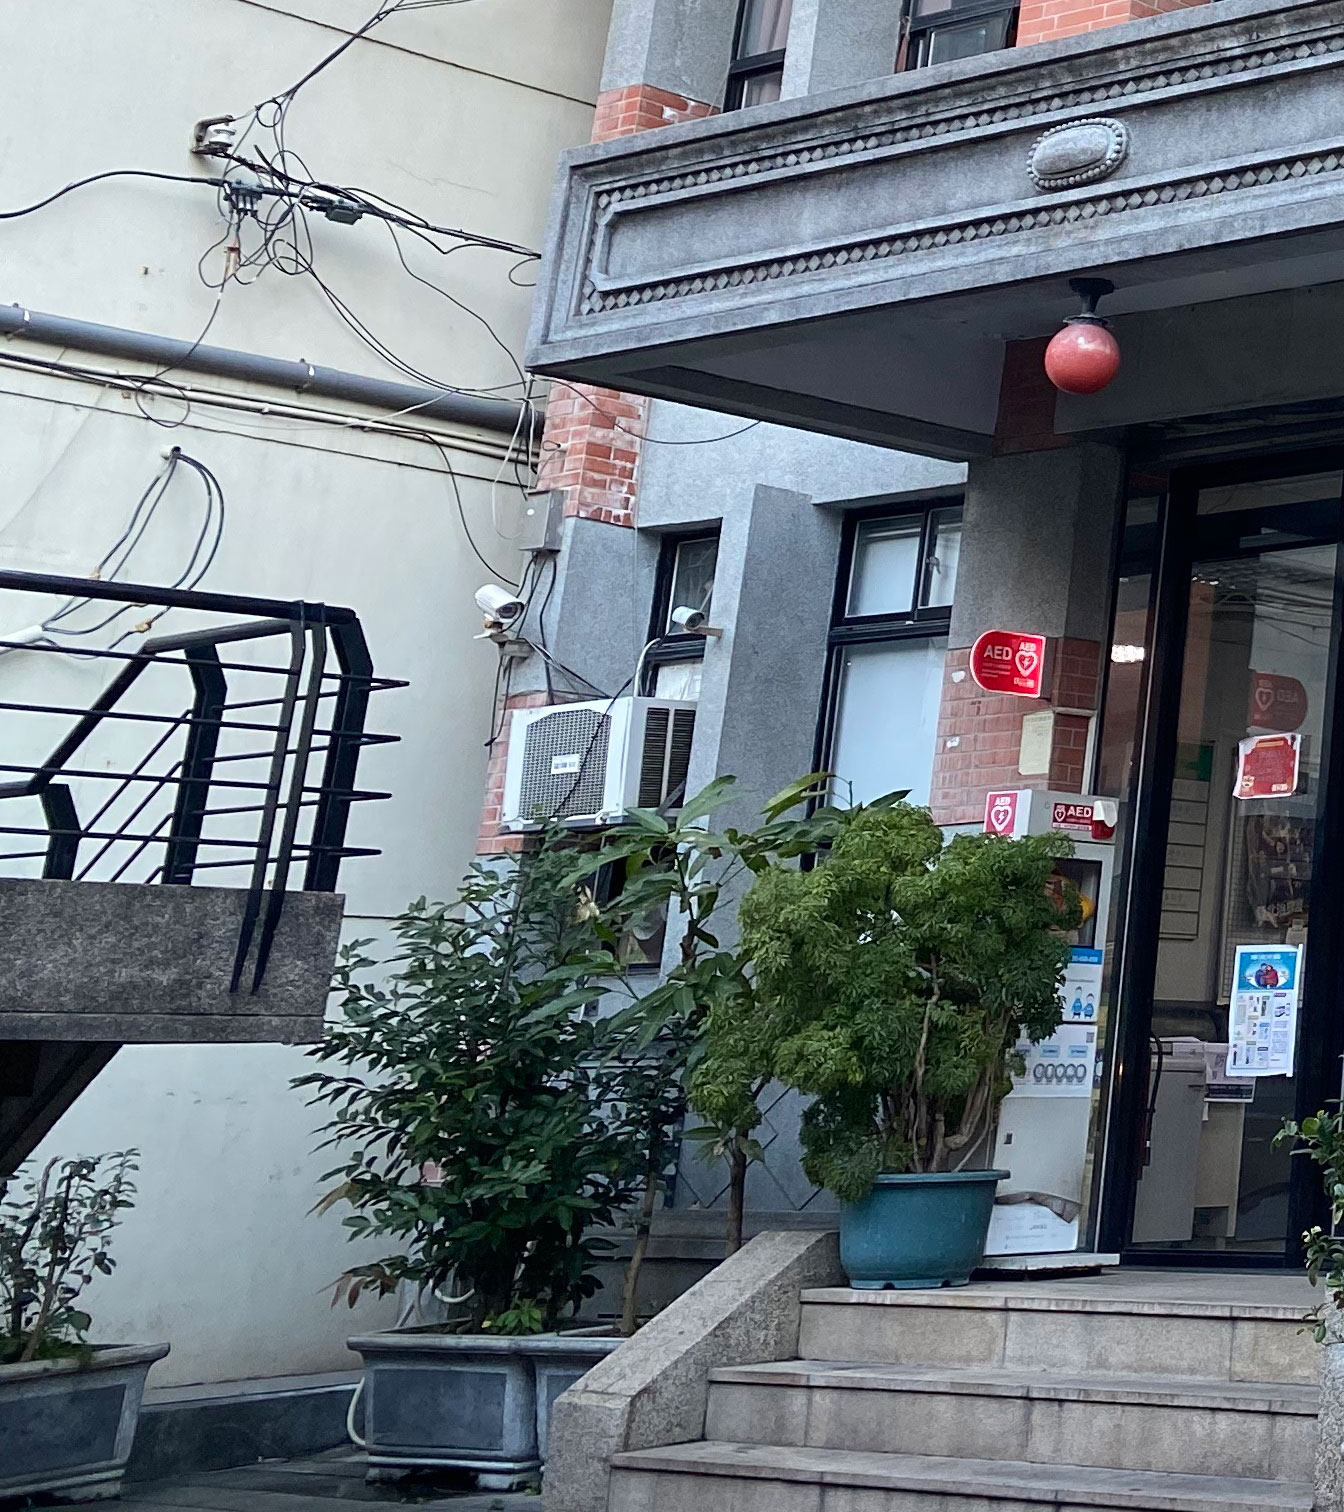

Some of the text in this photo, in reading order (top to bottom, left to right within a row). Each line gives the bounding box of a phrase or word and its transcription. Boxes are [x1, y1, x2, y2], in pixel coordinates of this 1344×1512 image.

[984, 644, 1012, 660] AED
[1018, 641, 1036, 652] AED
[994, 796, 1011, 806] AED
[1067, 806, 1092, 818] AED
